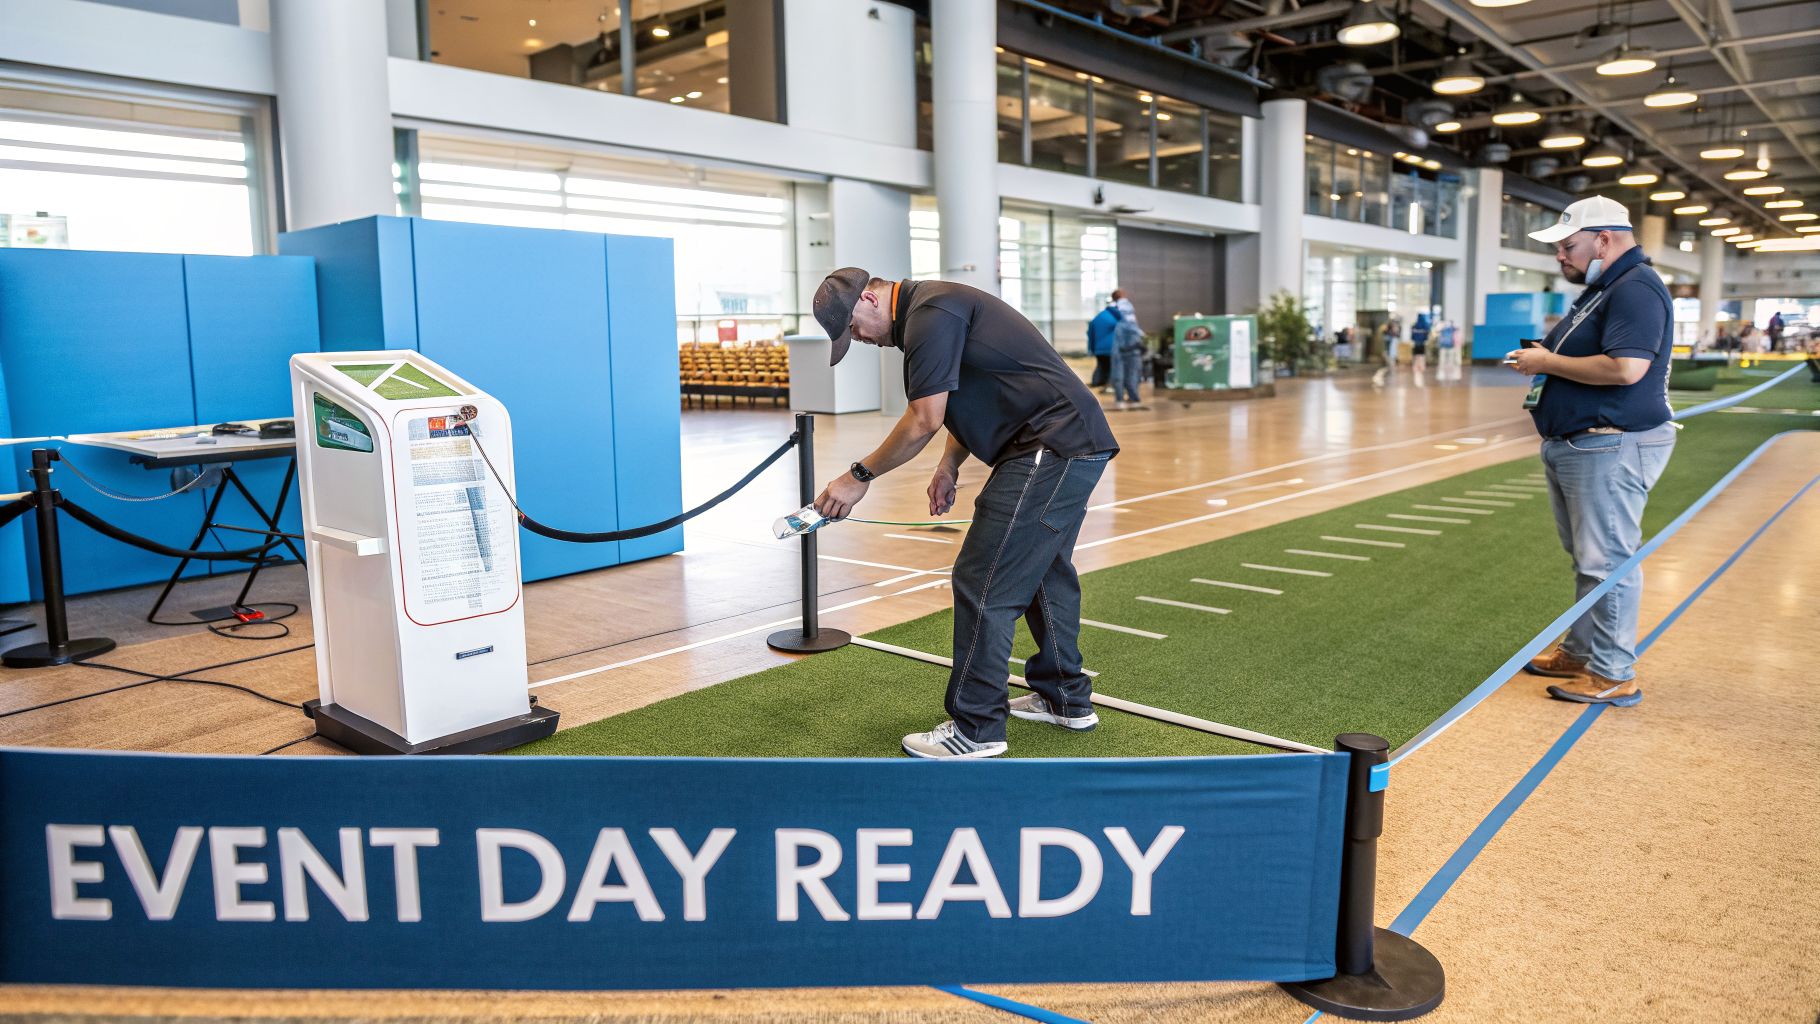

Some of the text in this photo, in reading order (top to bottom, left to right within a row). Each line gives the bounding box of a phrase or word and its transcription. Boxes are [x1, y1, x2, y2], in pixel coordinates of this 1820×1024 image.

[46, 824, 1186, 923] EVENT DAY READY
